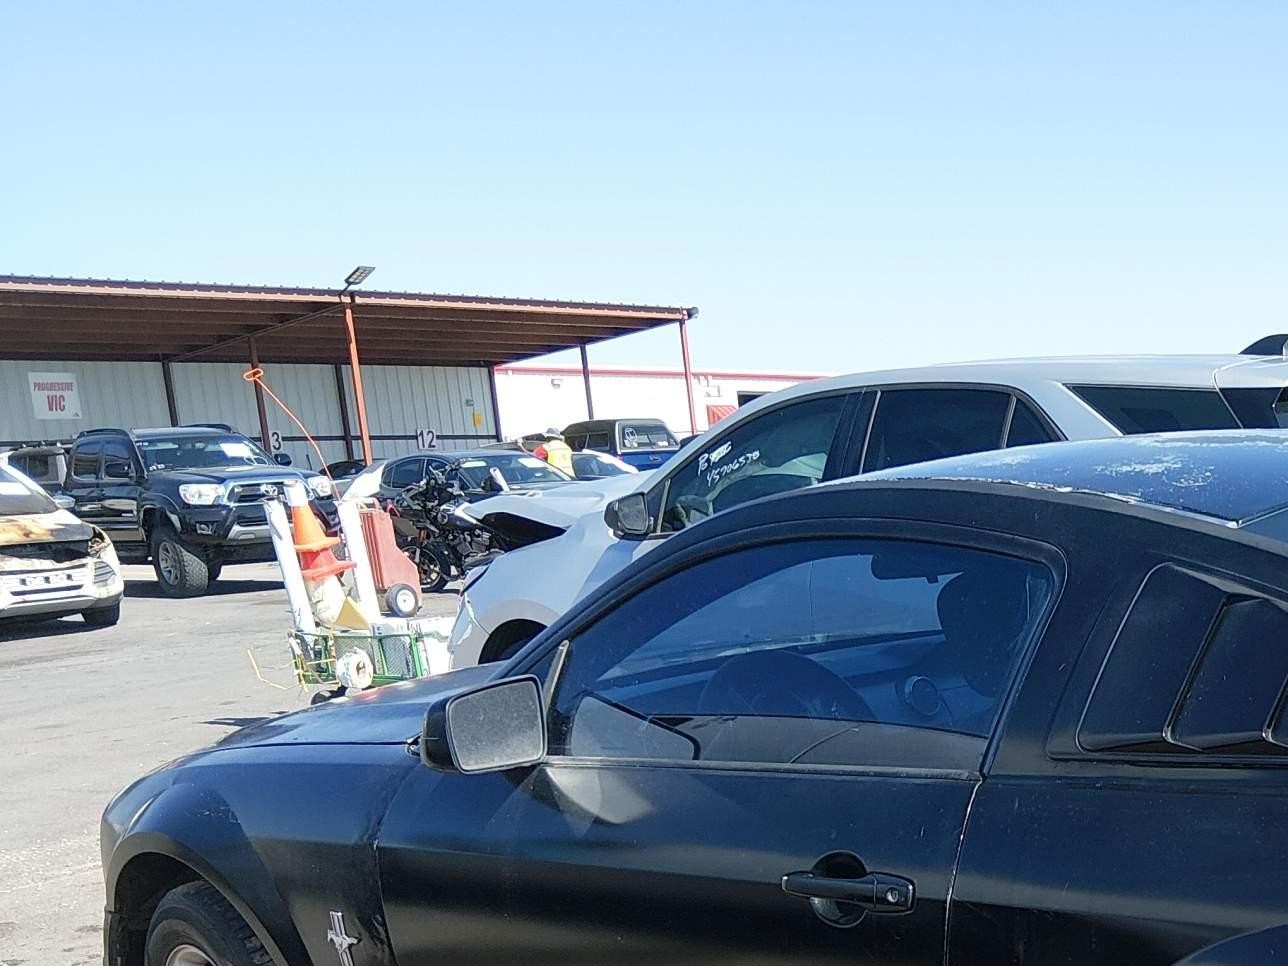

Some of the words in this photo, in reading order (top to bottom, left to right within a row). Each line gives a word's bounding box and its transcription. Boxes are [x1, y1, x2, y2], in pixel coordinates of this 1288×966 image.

[33, 381, 74, 392] PROGRESSIVE
[47, 395, 66, 412] VIC
[418, 430, 436, 449] 12
